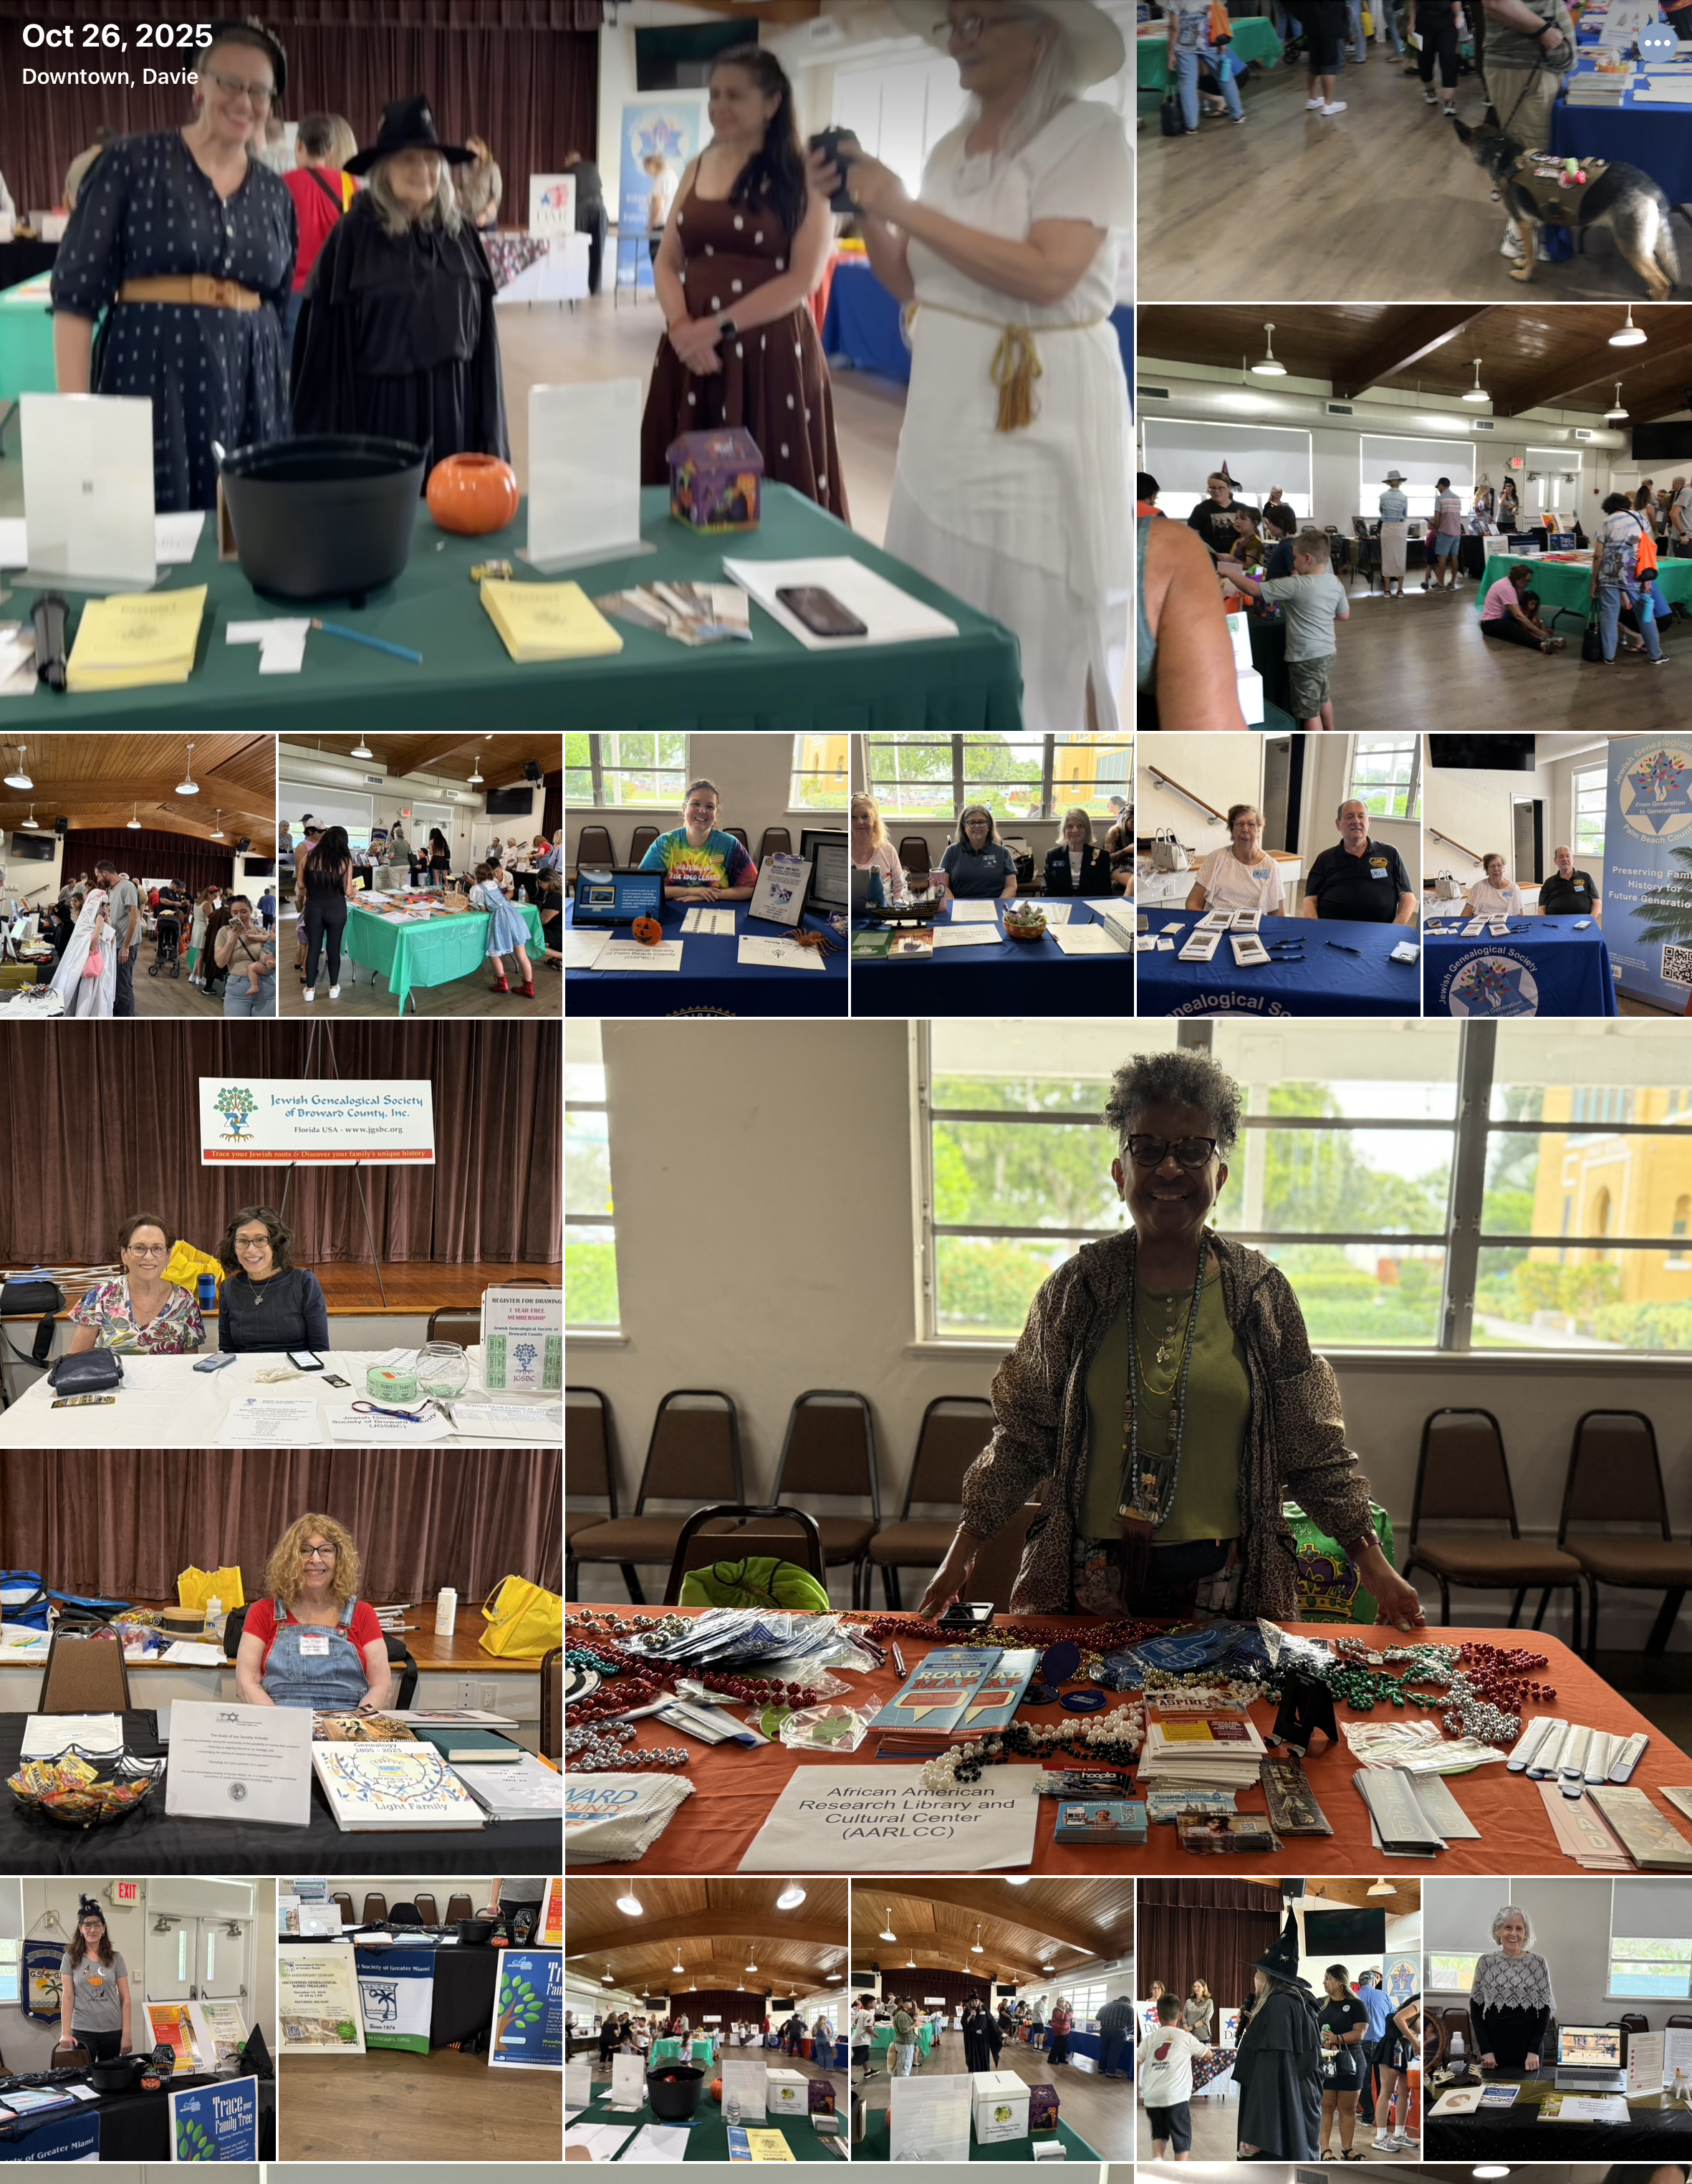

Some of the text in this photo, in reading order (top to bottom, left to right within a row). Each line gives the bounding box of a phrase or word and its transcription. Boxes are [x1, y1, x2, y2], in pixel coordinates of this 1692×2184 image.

[1614, 739, 1692, 785] Jewish Genealogical
[1623, 823, 1640, 839] Palm
[1612, 866, 1663, 879] Preserving
[1628, 881, 1682, 893] History for
[1609, 891, 1638, 901] Future
[1439, 946, 1537, 1005] Jewish Genealogical Society
[1491, 1000, 1522, 1014] Generation
[271, 1094, 423, 1107] Jewish Genealogical Society
[285, 1108, 410, 1119] of Broward County, Inc.
[345, 1126, 403, 1134] www.jgsbc.org
[918, 1670, 982, 1680] ROAD
[910, 1678, 978, 1690] MAP
[827, 1787, 994, 1797] African American
[409, 1803, 448, 1811] Family
[799, 1800, 1014, 1811] Research Library and
[825, 1813, 981, 1824] Cultural Center
[842, 1826, 954, 1839] (AARLCC)
[119, 1882, 136, 1899] EXIT
[213, 2096, 252, 2119] Trace your
[216, 2113, 252, 2135] Family Tree
[37, 2145, 69, 2159] Greater
[72, 2137, 94, 2150] Miami
